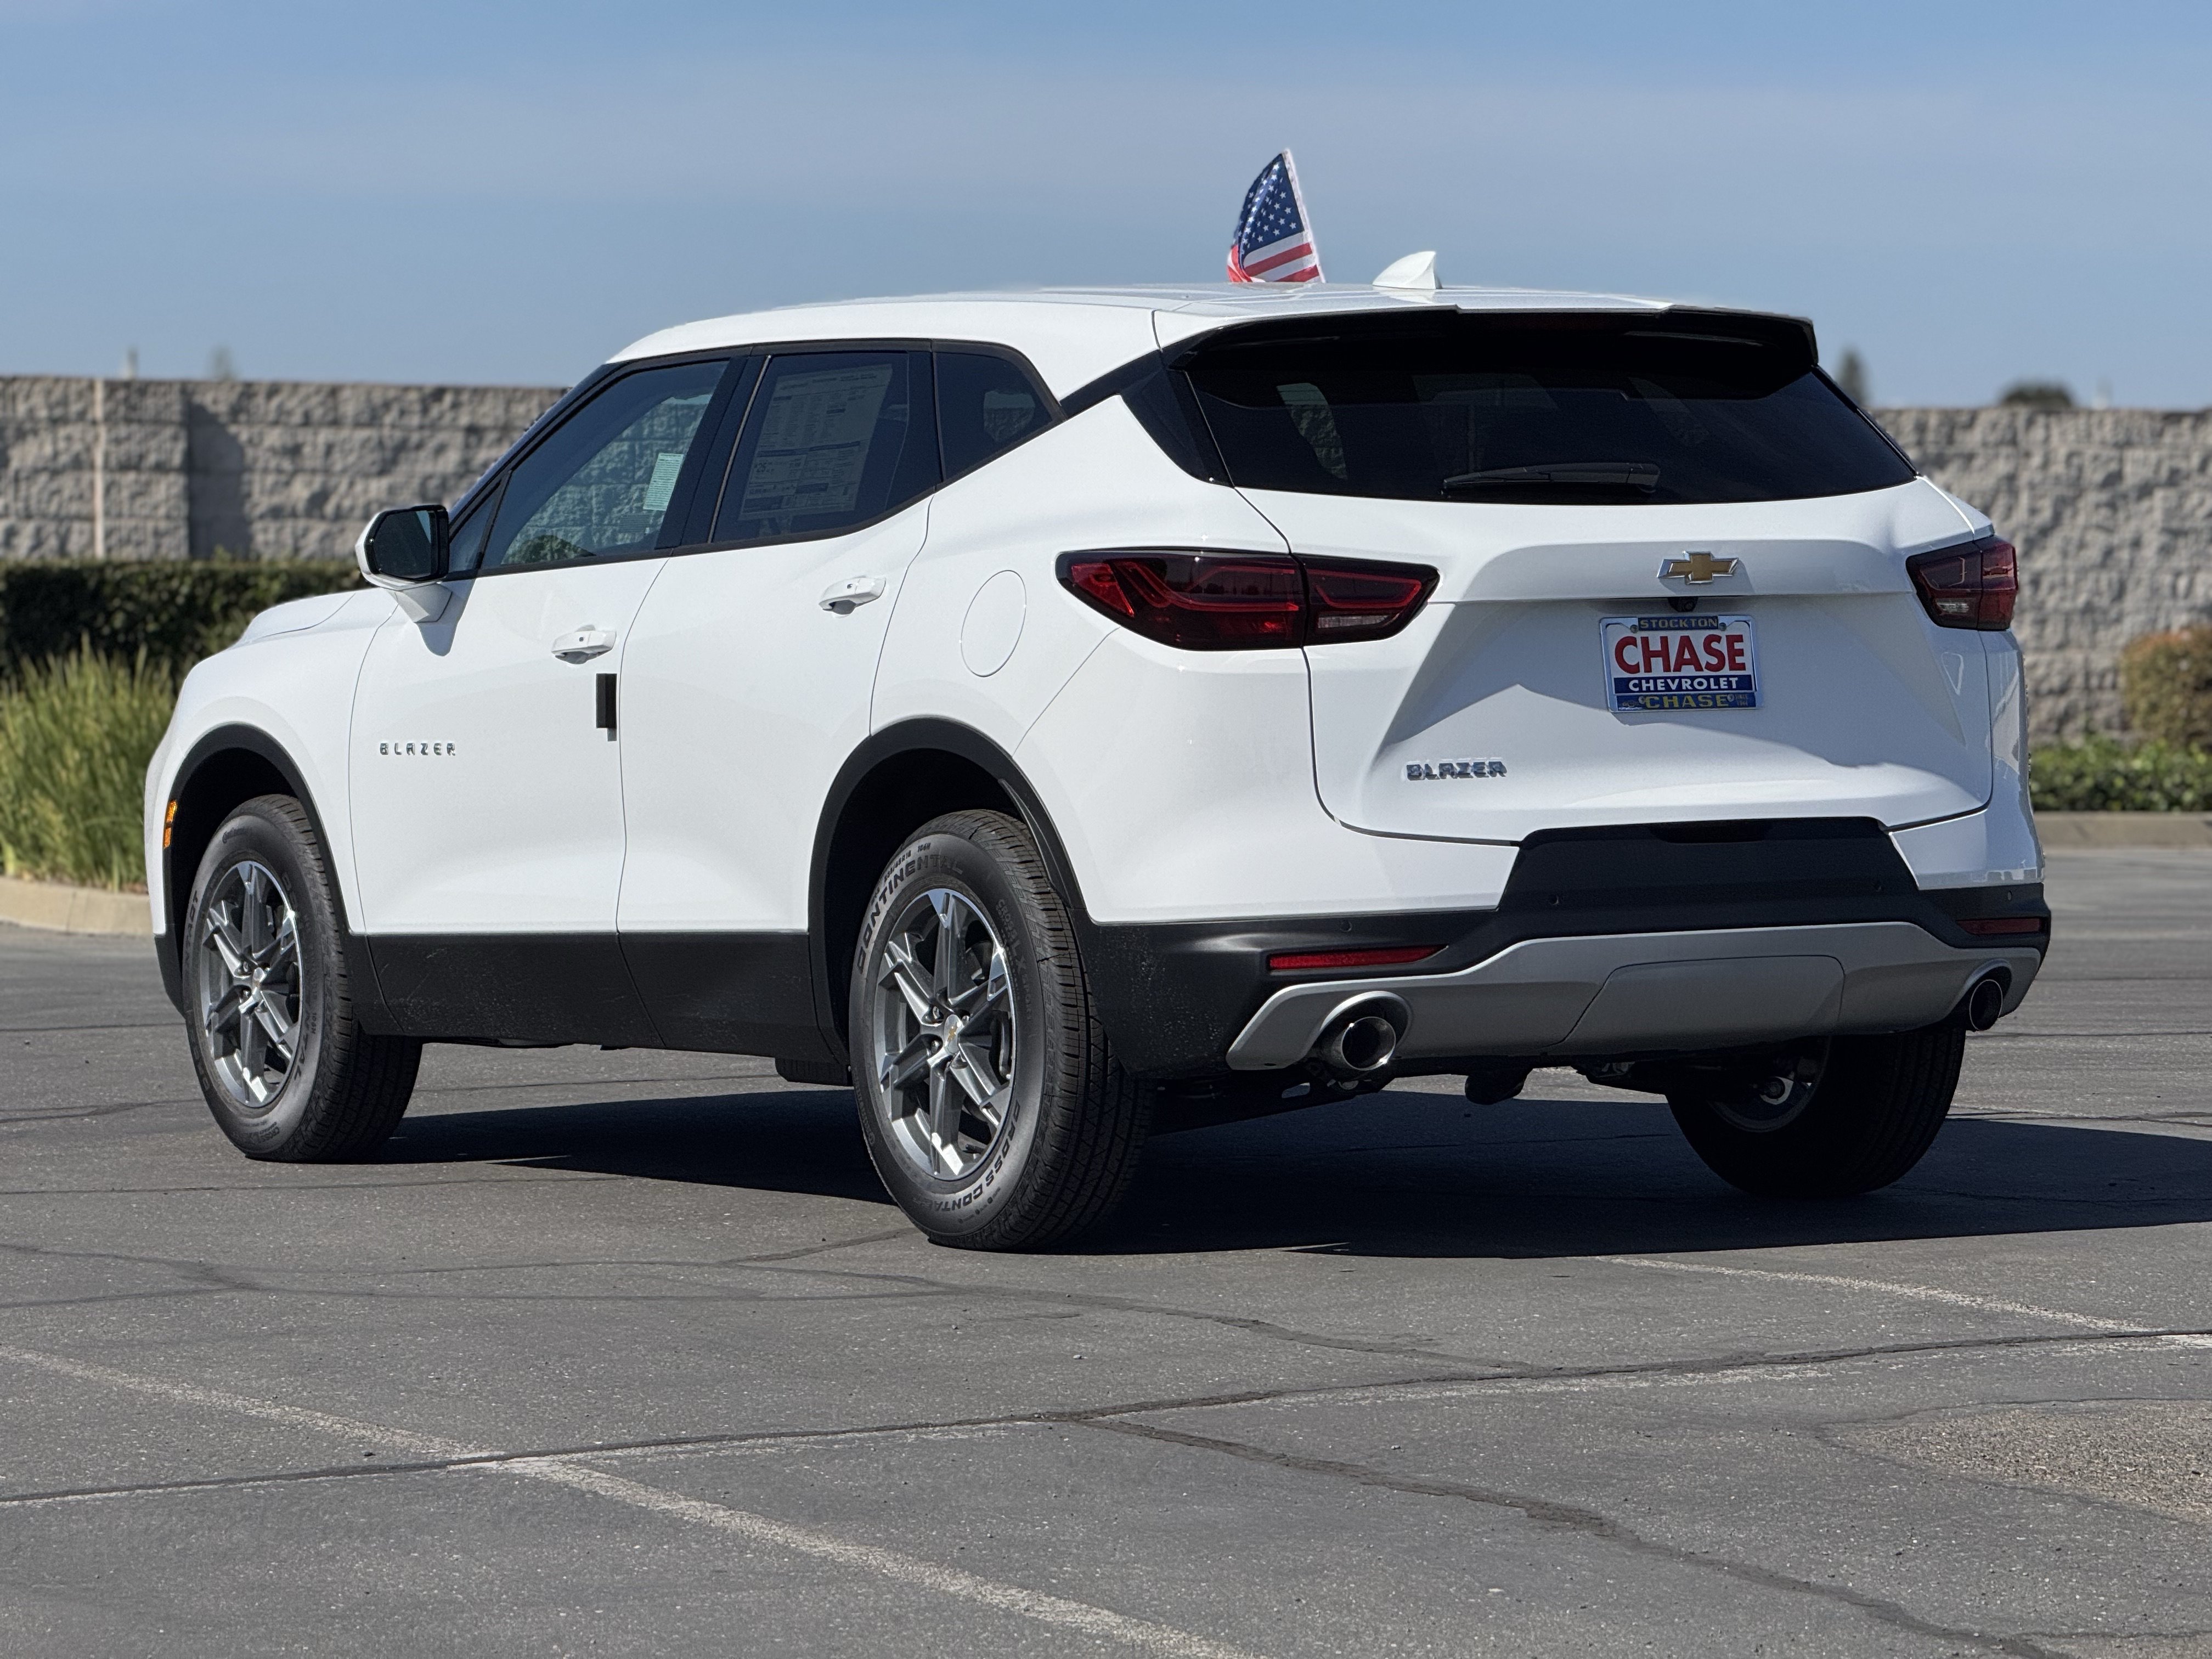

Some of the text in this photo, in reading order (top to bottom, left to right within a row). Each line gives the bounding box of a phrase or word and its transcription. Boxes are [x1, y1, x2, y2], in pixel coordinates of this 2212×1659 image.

[1639, 618, 1718, 629] STOCKTON
[1614, 634, 1746, 674] CHASE
[1628, 677, 1739, 691] CHEVROLET
[1645, 694, 1729, 708] CHASE
[380, 742, 456, 757] BLAZER
[1406, 760, 1508, 781] BLAZER
[857, 854, 963, 974] CONTINENTAL
